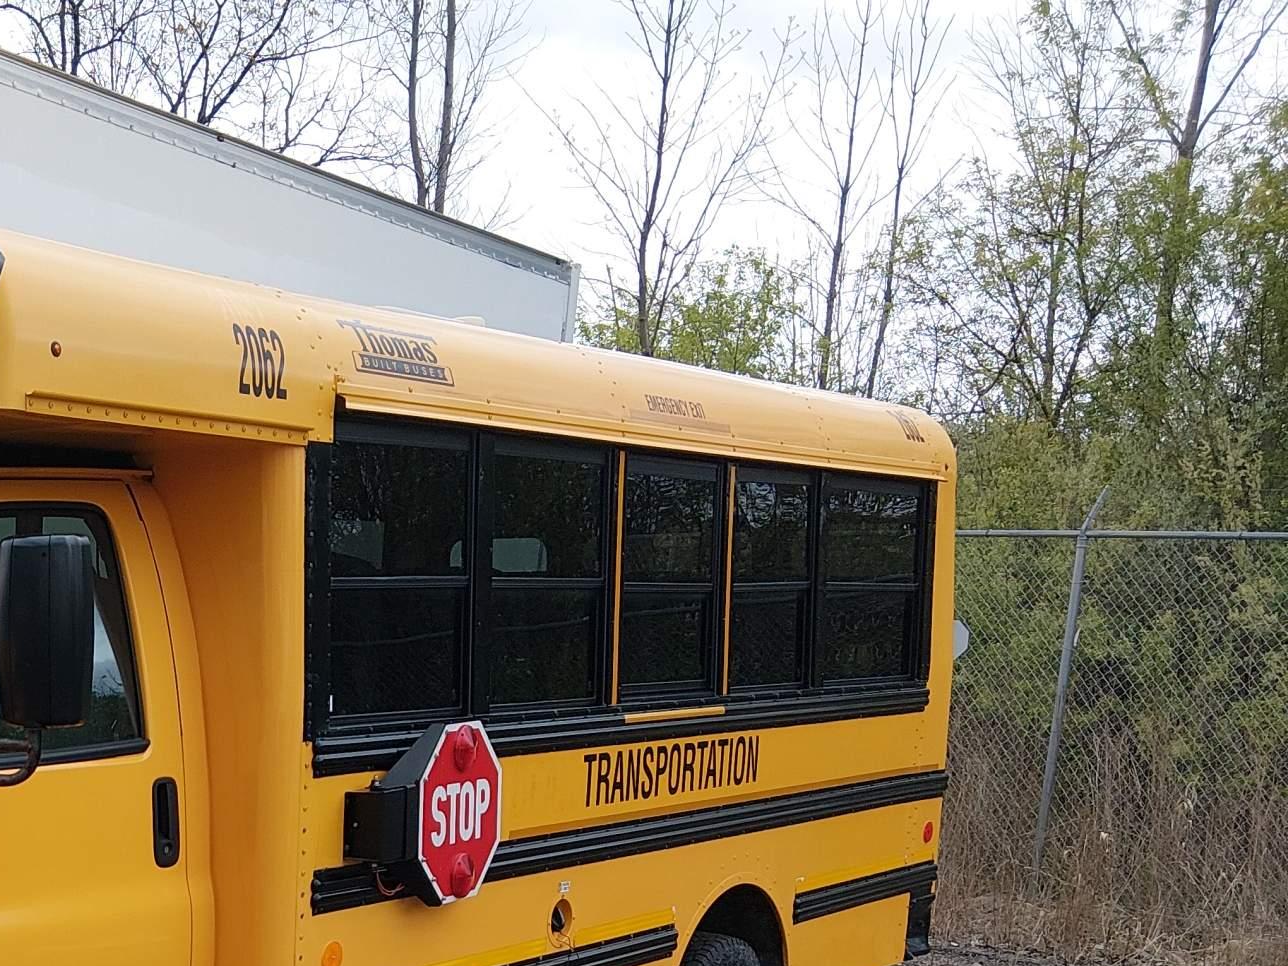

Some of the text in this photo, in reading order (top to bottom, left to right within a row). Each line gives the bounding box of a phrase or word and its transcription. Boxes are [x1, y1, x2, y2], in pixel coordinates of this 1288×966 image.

[232, 322, 288, 400] 2062
[336, 319, 438, 365] Thomas
[363, 355, 447, 380] BUILT BUSES
[644, 393, 691, 417] EMERGENCY
[583, 735, 760, 807] TRANSPORTATION
[430, 778, 491, 847] STOP
